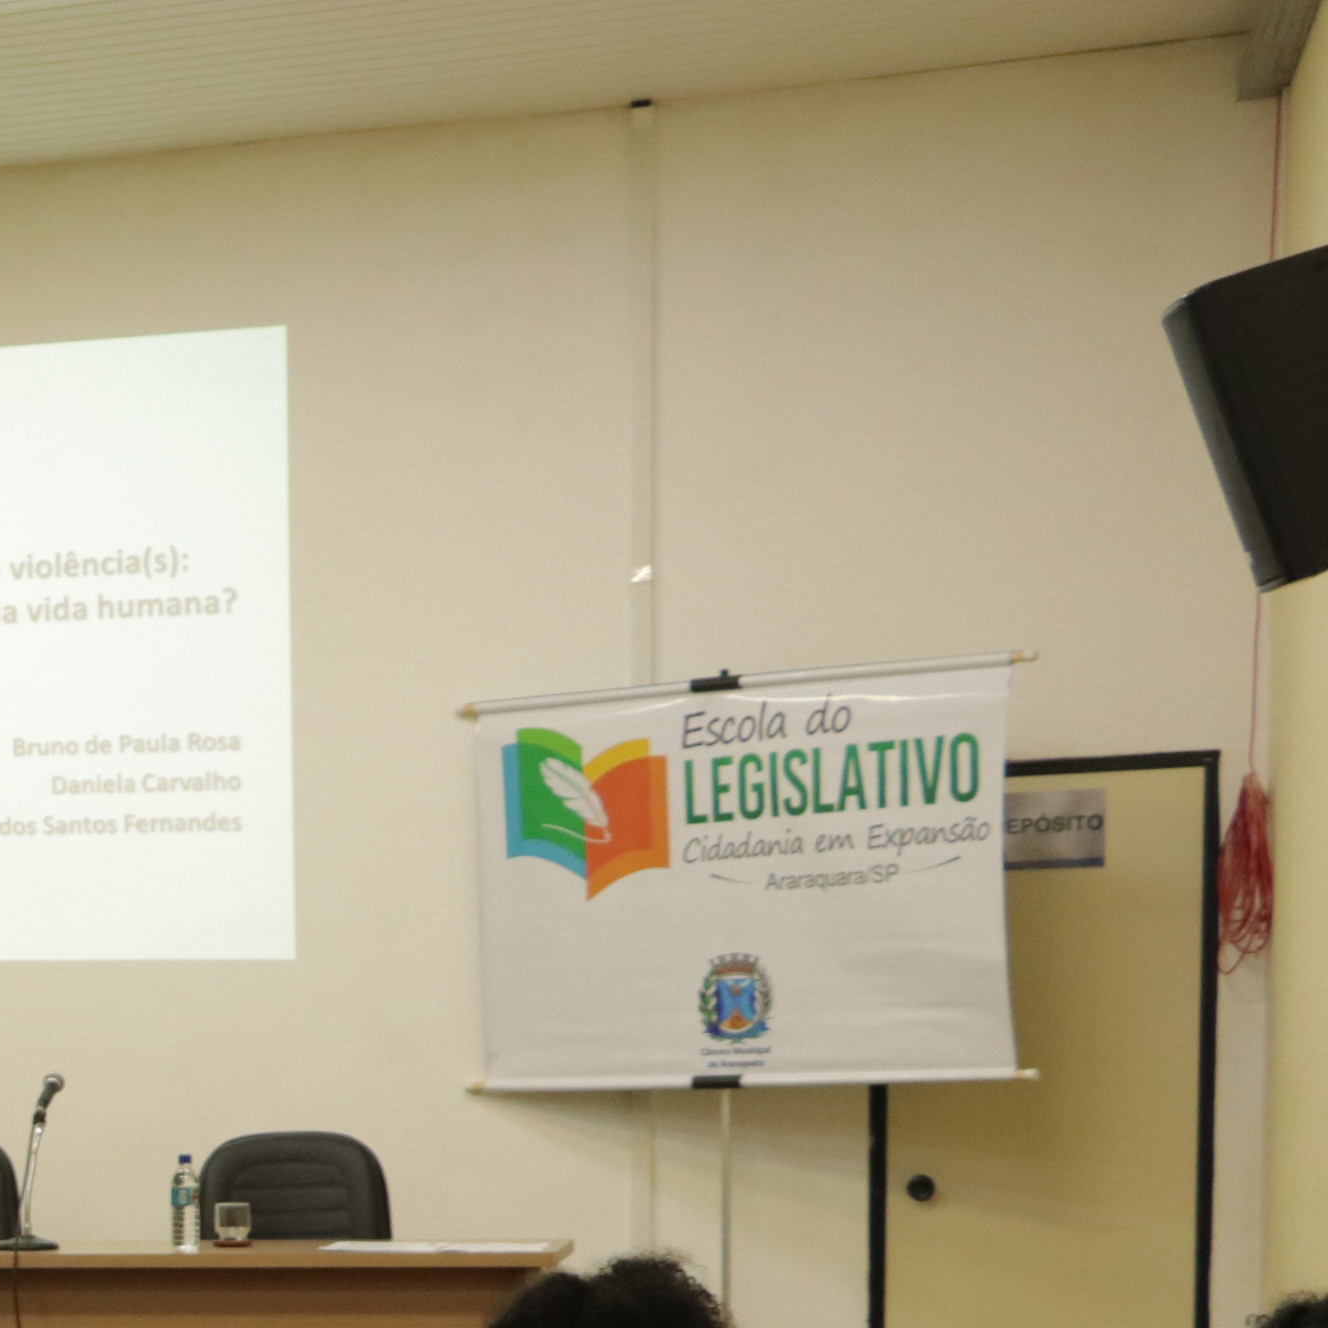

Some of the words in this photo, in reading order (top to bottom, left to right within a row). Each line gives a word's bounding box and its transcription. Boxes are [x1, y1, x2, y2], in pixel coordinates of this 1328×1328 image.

[10, 545, 190, 580] violência(s):
[27, 595, 88, 622] vida
[97, 586, 239, 619] humana?
[681, 701, 787, 749] Escola
[805, 693, 852, 735] do
[12, 737, 79, 757] Bruno
[85, 734, 112, 754] de
[119, 732, 181, 753] Paula
[188, 732, 242, 752] Rosa
[51, 773, 137, 796] Daniela
[142, 771, 243, 793] Carvalho
[684, 732, 979, 824] LEGISLATIVO
[43, 815, 118, 835] Santos
[123, 811, 243, 833] Fernandes
[1006, 813, 1104, 834] EPÓSITO
[682, 829, 804, 863] Cidadania
[814, 832, 855, 852] em
[867, 816, 991, 856] Expansão
[764, 863, 900, 891] Araraquara/SP
